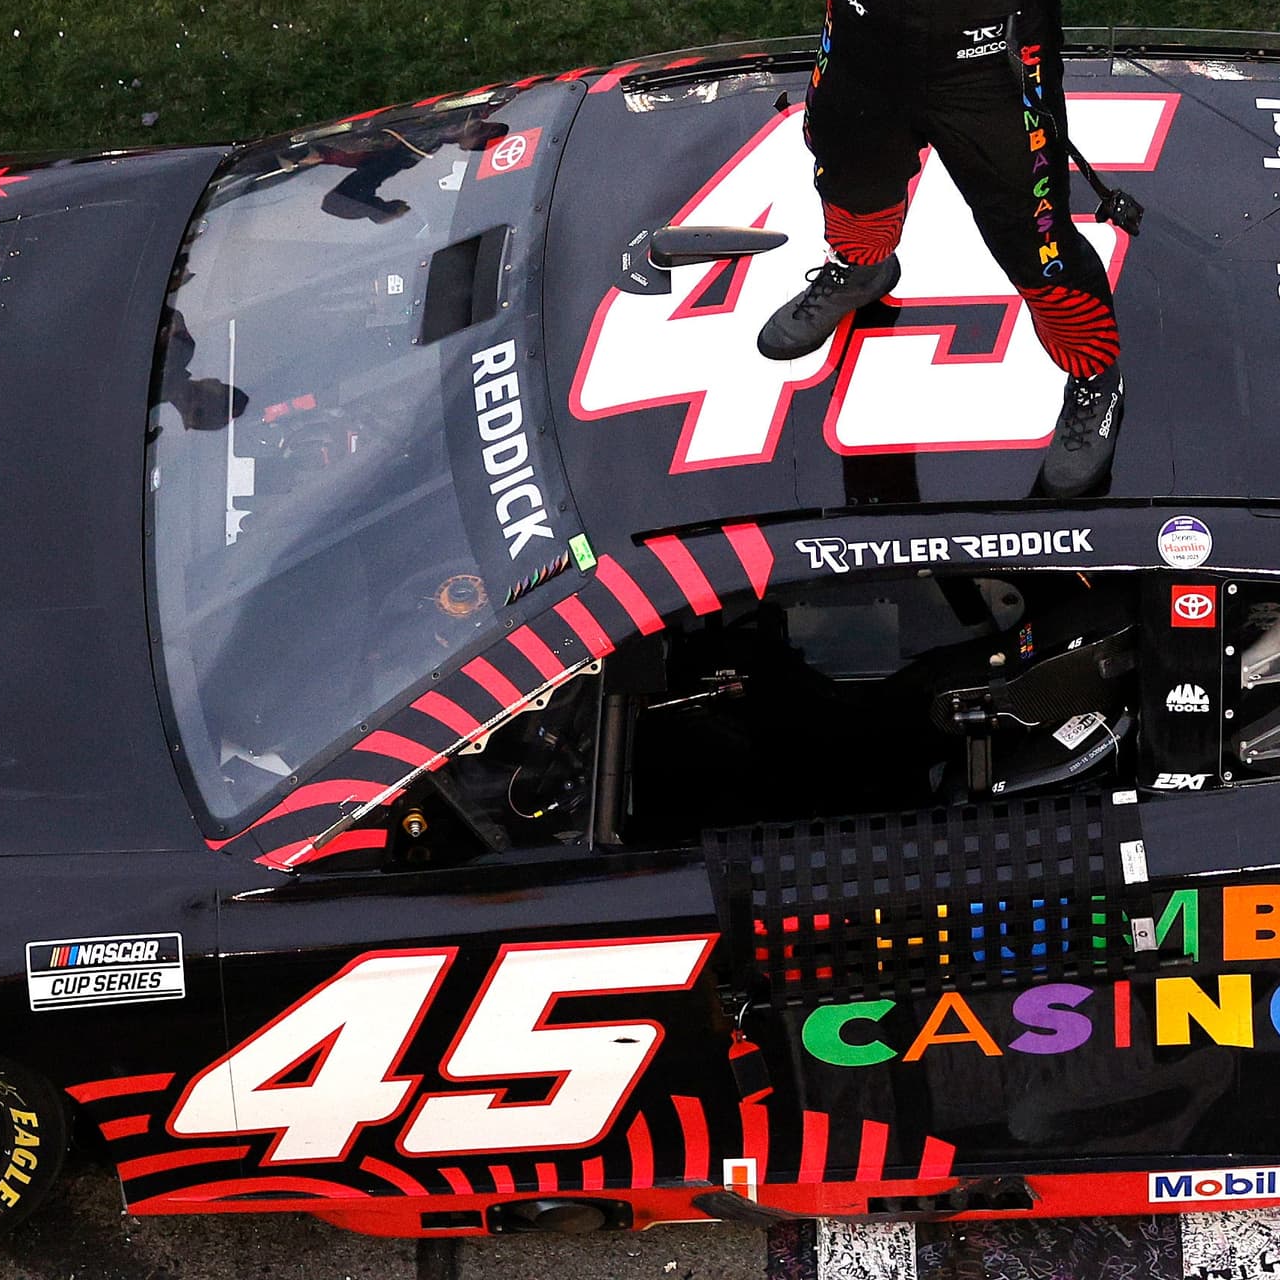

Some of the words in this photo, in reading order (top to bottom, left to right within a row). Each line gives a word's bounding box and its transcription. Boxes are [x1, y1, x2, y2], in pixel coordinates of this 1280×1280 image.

[471, 338, 554, 560] REDDICK
[848, 536, 951, 566] TYLER
[951, 528, 1093, 558] REDDICK
[1164, 541, 1206, 553] Hamlin
[1166, 682, 1210, 705] MAC
[1166, 704, 1210, 713] TOOLS
[74, 939, 160, 967] NASCAR
[50, 973, 91, 996] CUP
[93, 970, 163, 994] SERIES
[166, 933, 720, 1167] 45
[1154, 1171, 1276, 1198] Mobil
